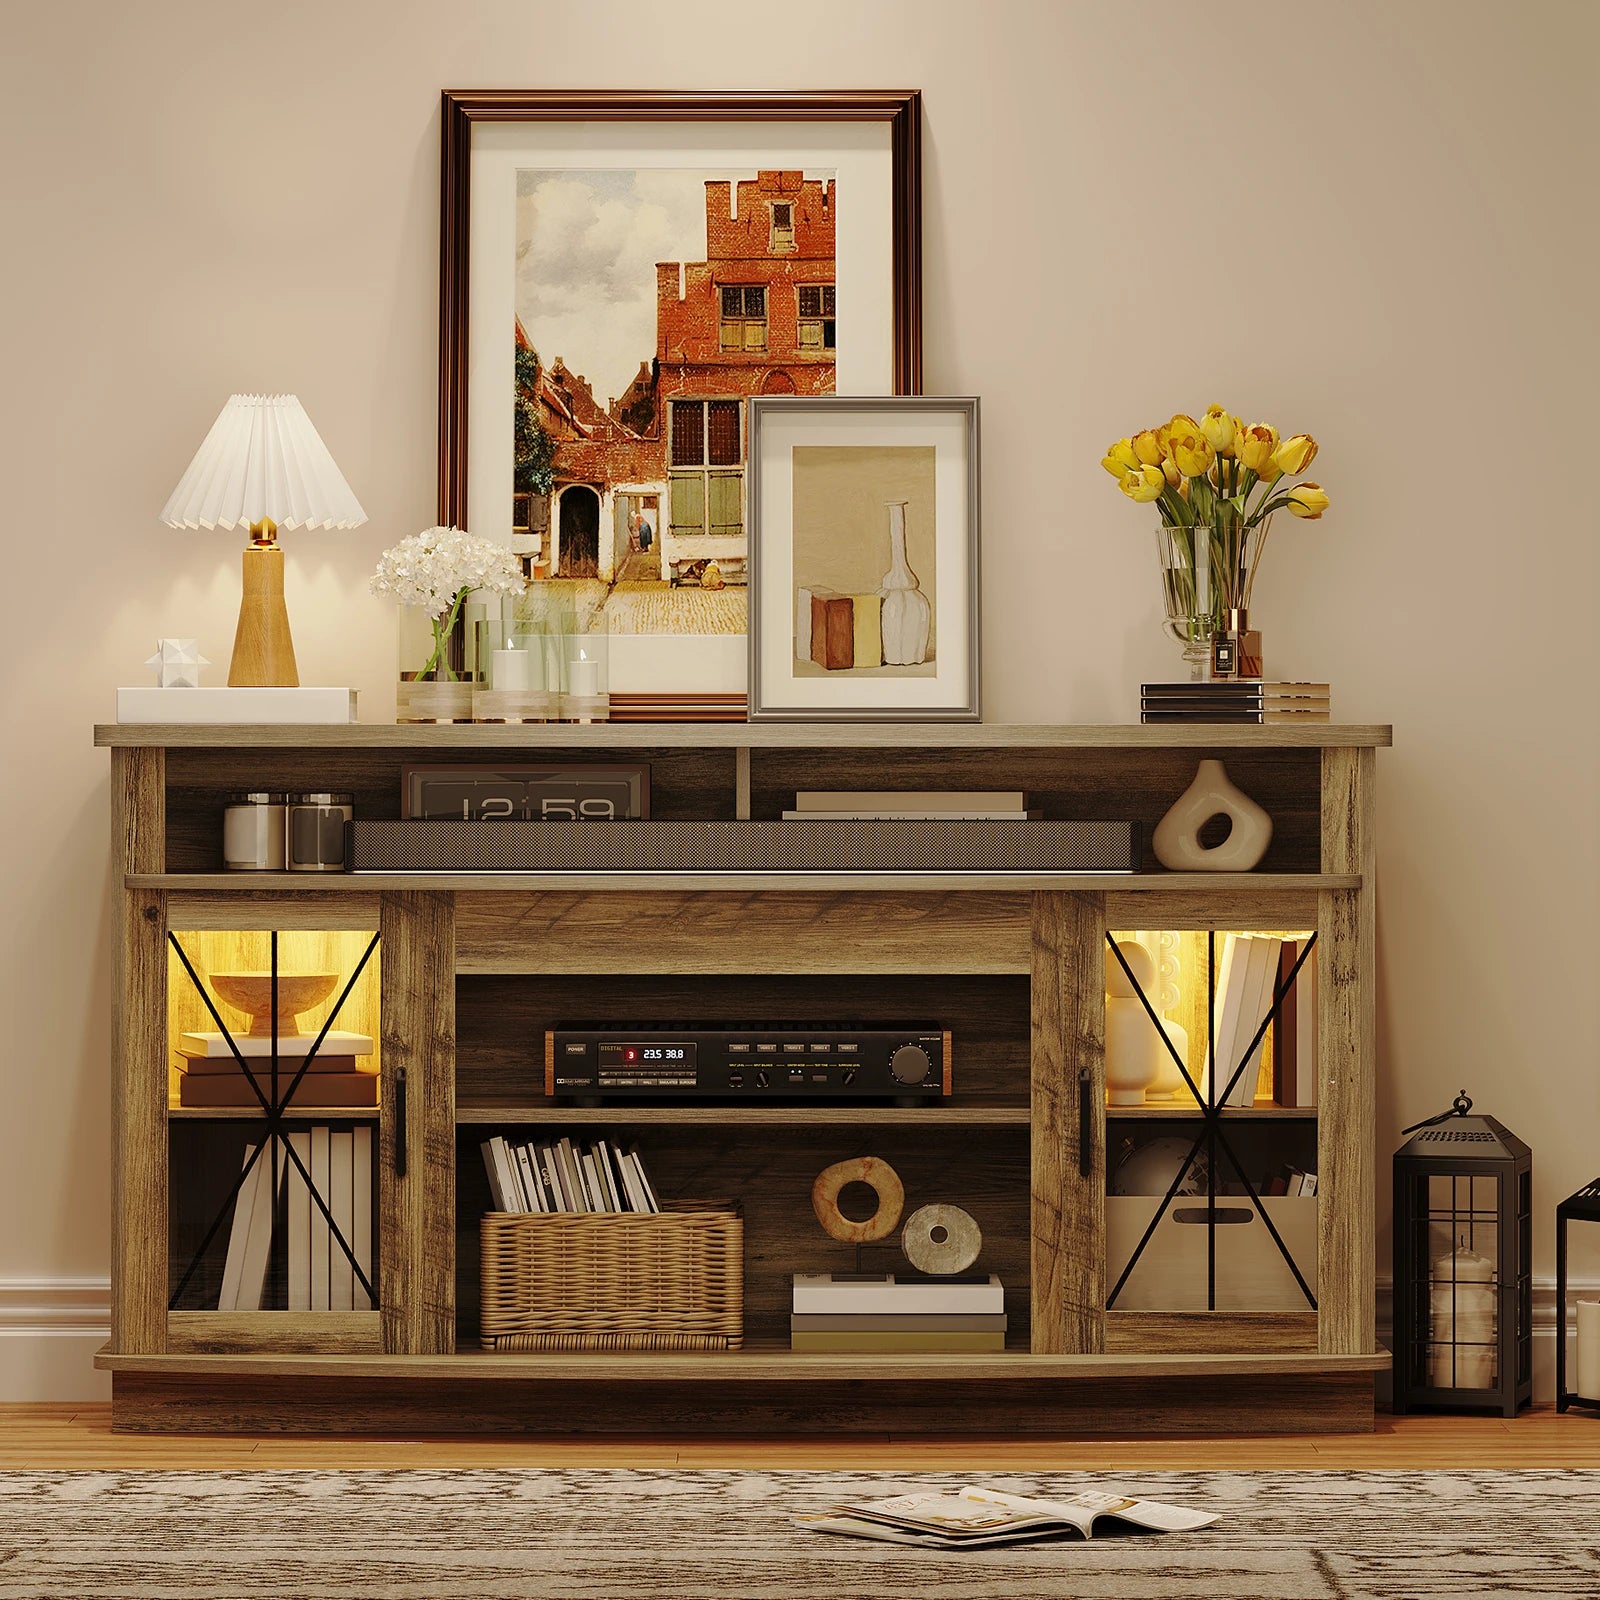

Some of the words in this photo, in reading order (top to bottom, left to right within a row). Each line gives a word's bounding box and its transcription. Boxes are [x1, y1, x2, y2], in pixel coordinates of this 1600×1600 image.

[463, 798, 513, 820] 12
[541, 798, 615, 820] 59
[628, 1051, 634, 1059] 3
[643, 1049, 662, 1059] 23.5
